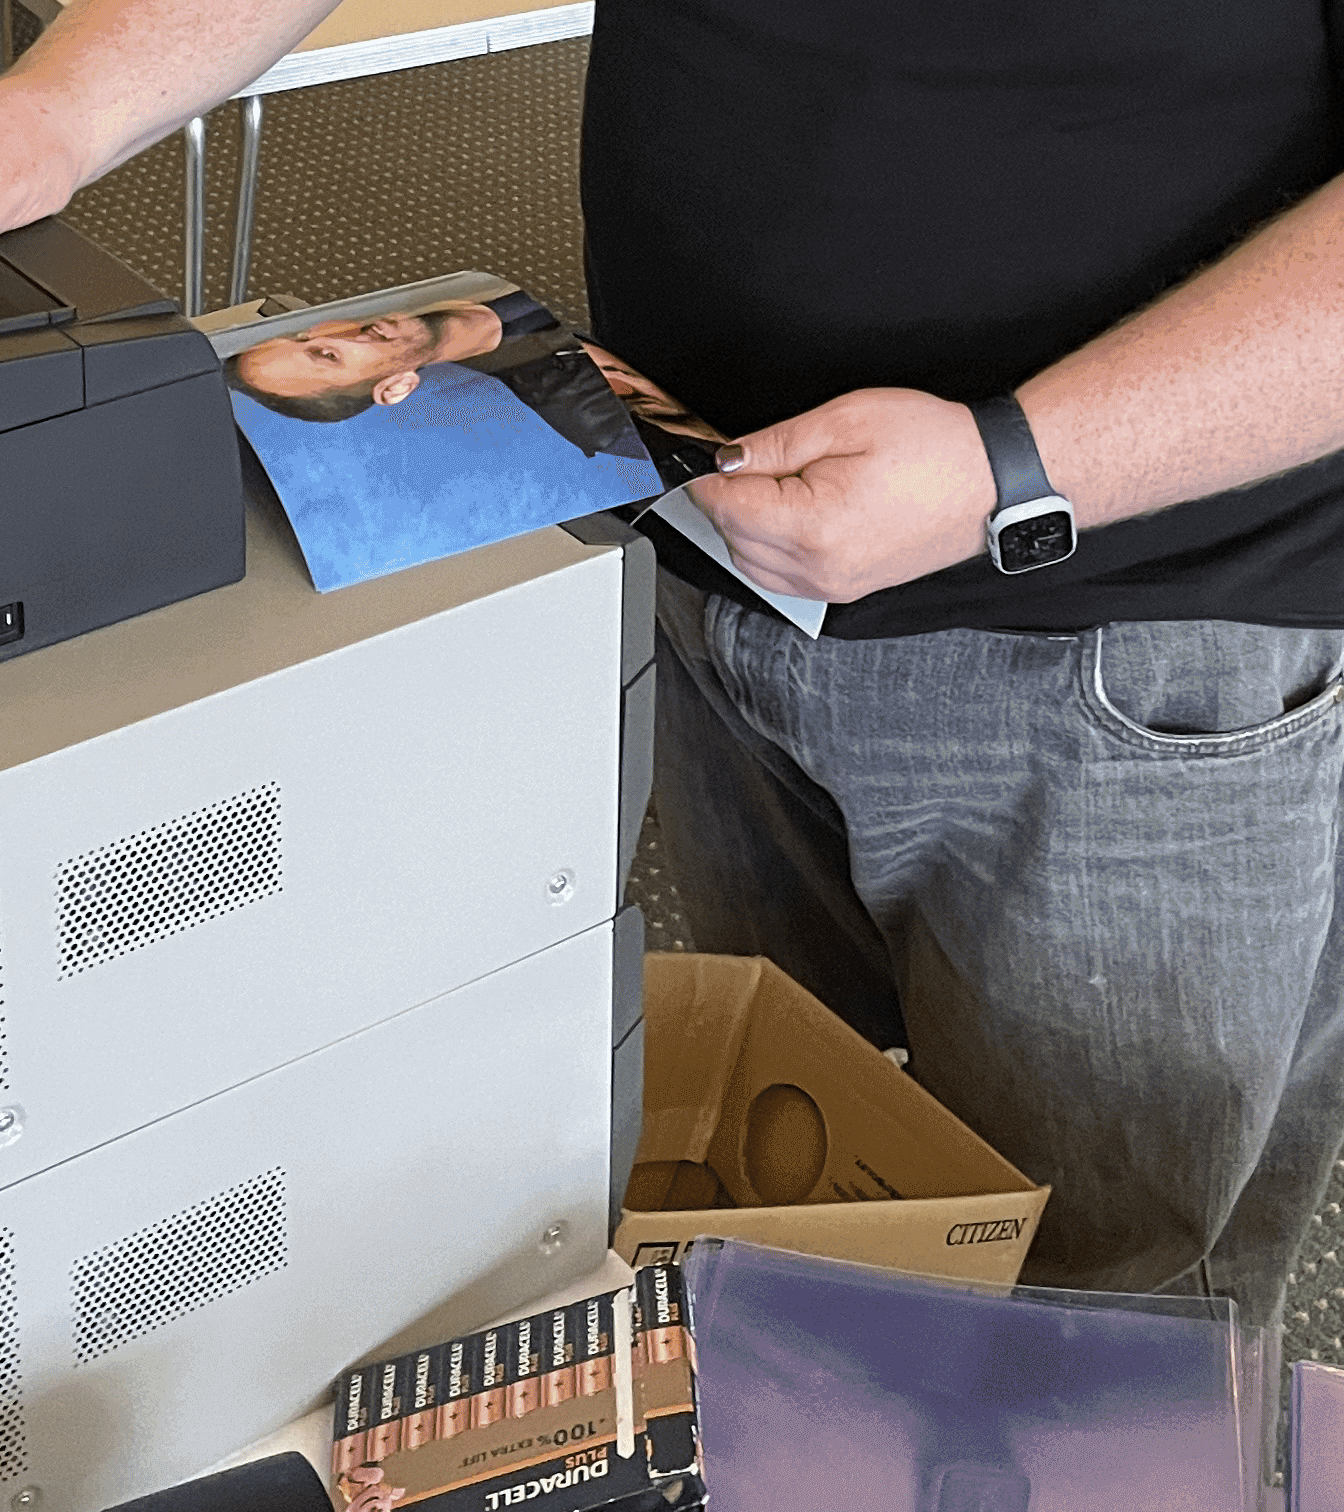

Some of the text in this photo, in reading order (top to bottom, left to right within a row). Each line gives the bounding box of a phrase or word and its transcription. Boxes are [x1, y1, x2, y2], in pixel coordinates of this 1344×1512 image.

[946, 1217, 1028, 1246] CITIZEN
[537, 1420, 597, 1446] 100%
[565, 1447, 607, 1469] PLUS
[485, 1459, 608, 1511] DURACELL
